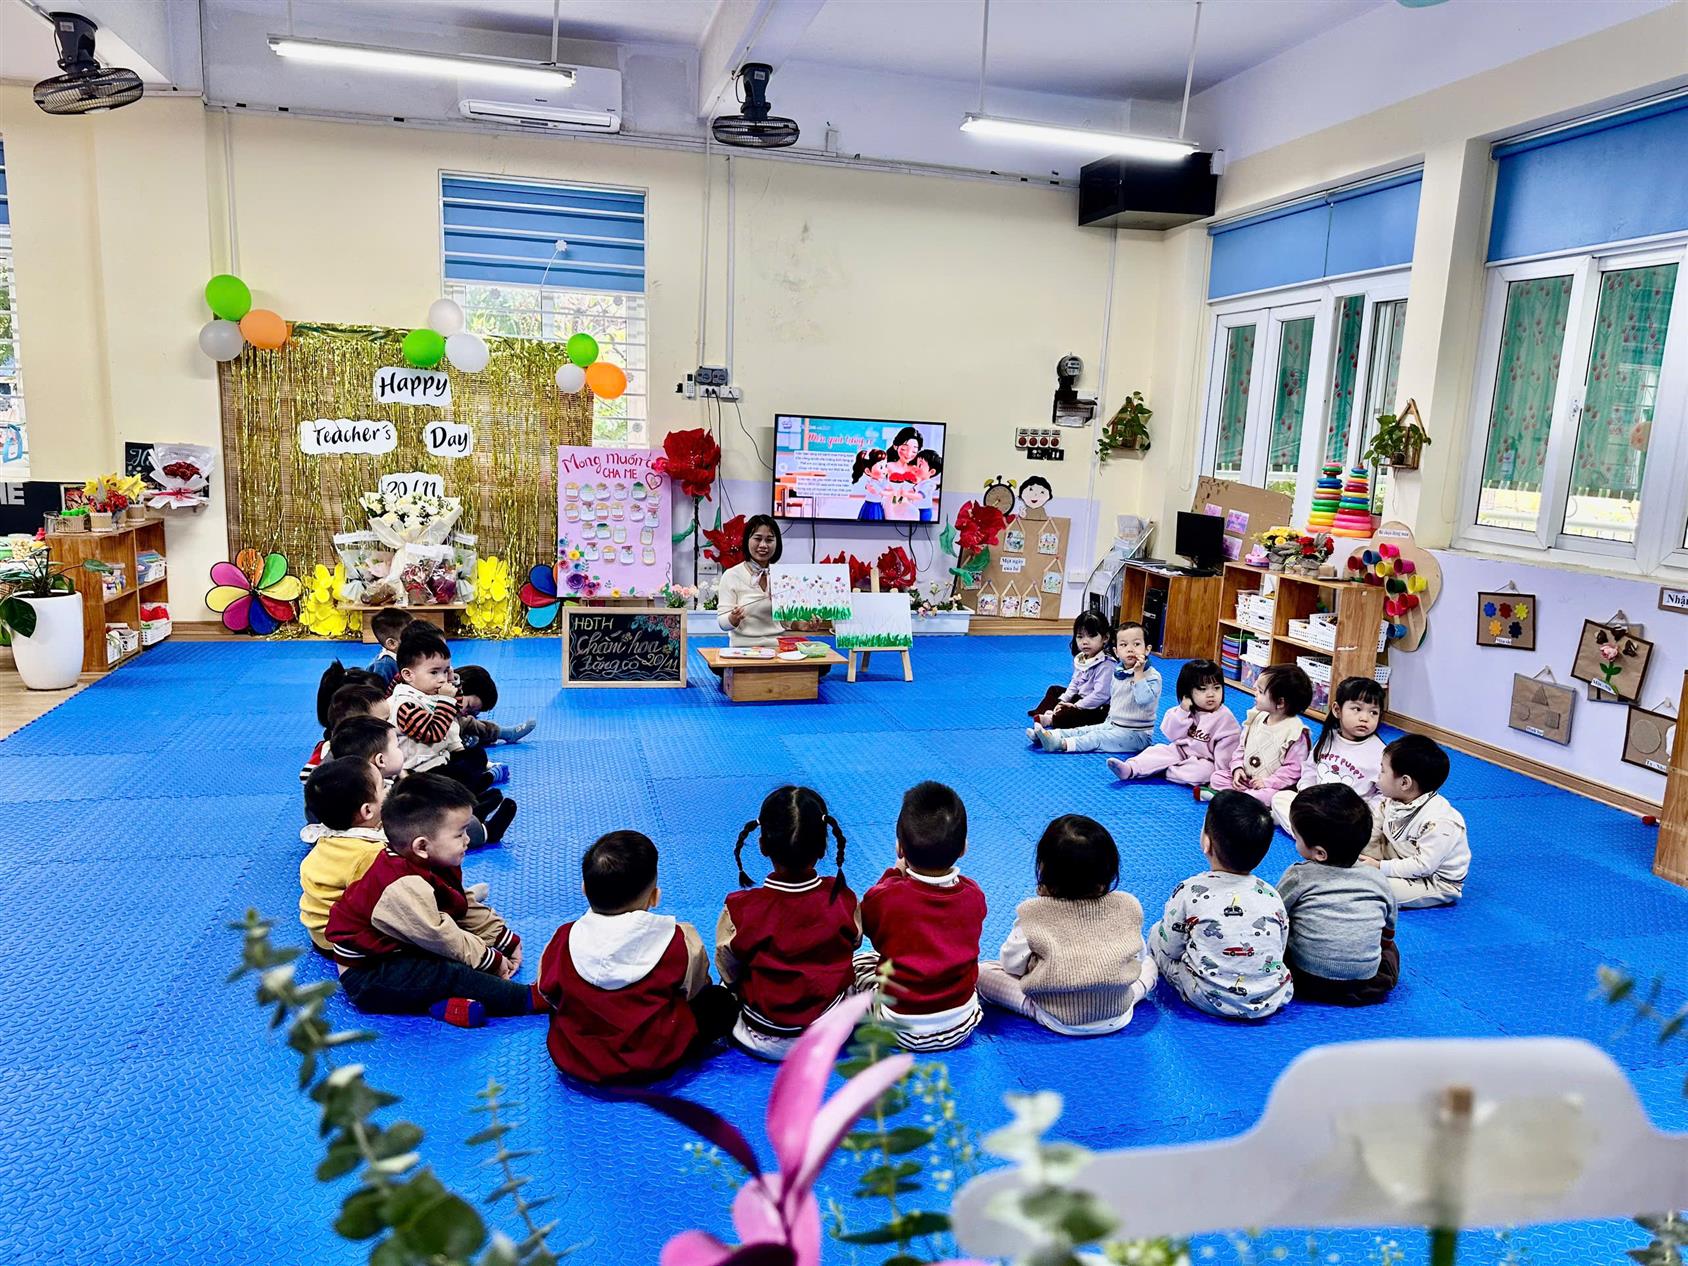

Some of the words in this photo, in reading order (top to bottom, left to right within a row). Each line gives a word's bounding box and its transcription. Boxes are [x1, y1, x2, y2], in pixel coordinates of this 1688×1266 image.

[379, 372, 448, 397] Happy
[430, 426, 468, 452] Day
[561, 453, 602, 474] Mong
[602, 467, 621, 479] CHA
[574, 617, 614, 631] HĐTH
[627, 630, 663, 654] hoa
[1340, 757, 1365, 780] PUPPY
